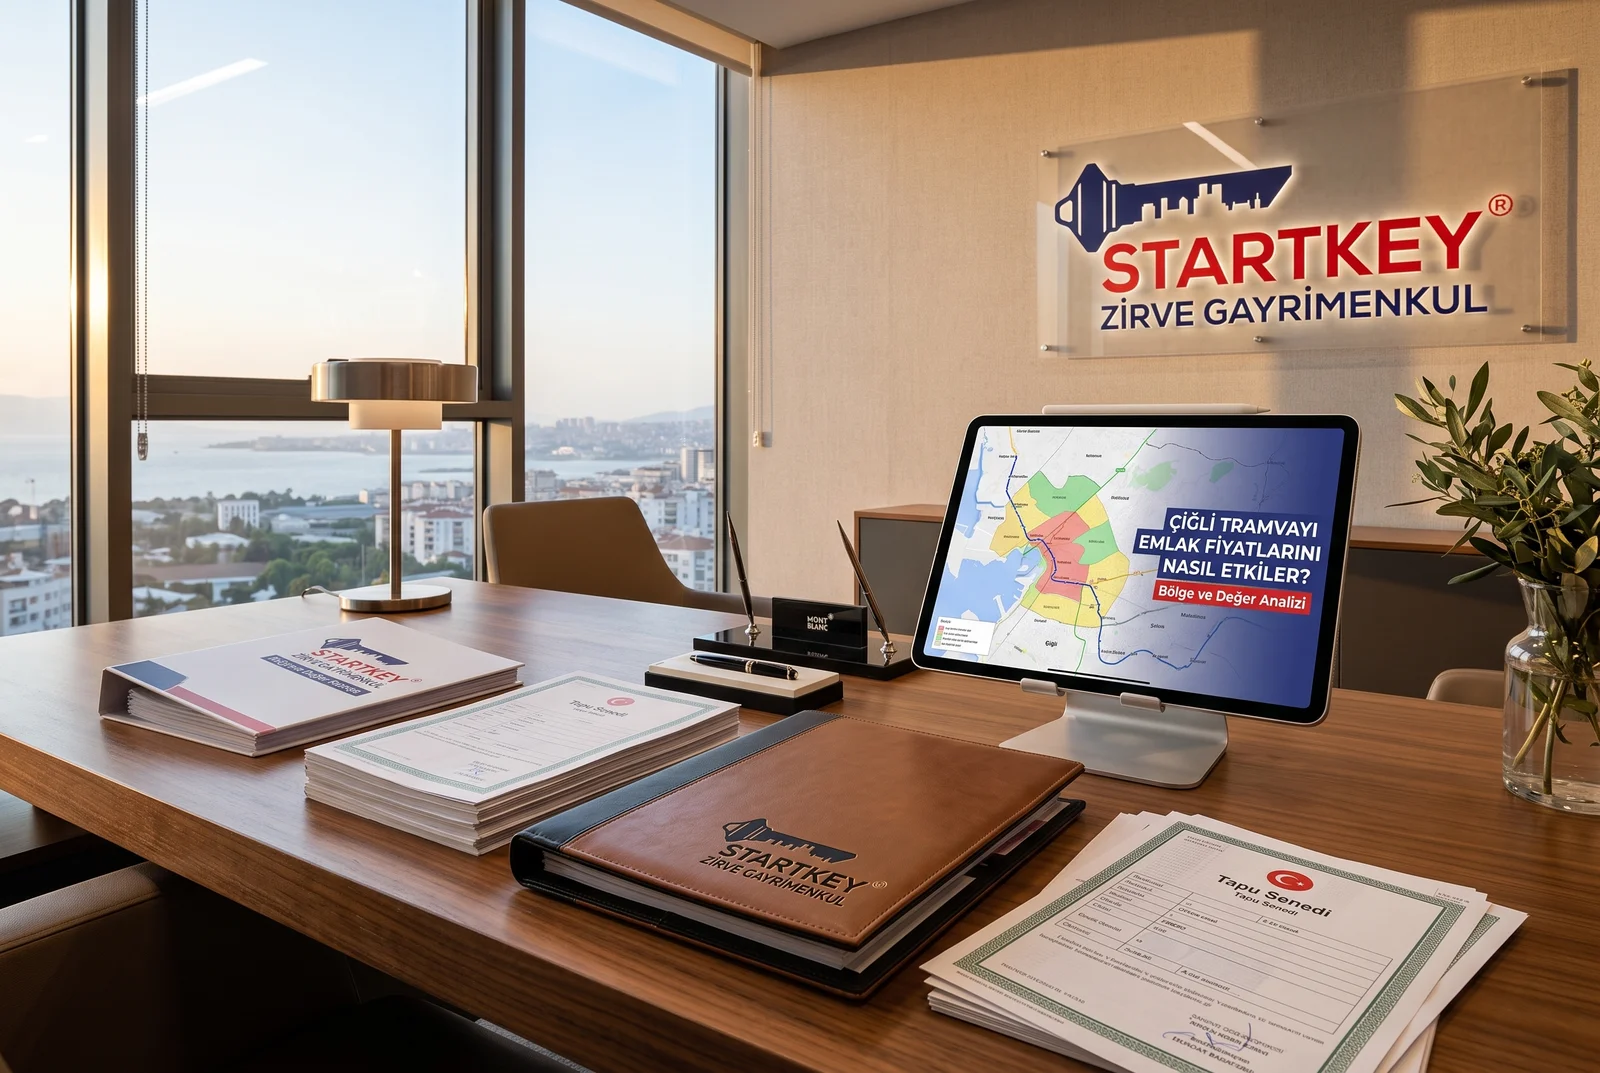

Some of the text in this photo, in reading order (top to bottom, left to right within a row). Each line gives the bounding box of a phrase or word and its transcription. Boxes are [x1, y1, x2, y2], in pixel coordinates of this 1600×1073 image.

[1102, 211, 1483, 293] STARTKEY
[1100, 284, 1488, 330] ZİRVE GAYRİMENKUL
[1169, 511, 1318, 538] ÇİĞLİ TRAMVAYI
[1138, 534, 1322, 562] EMLAK FİYATLARINI
[1162, 558, 1311, 585] NASIL ETKİLER?
[1158, 585, 1307, 610] Bölge ve Değer Analizi
[807, 615, 828, 625] MONT
[807, 622, 829, 631] BLANC
[311, 649, 409, 683] STARTKEY
[700, 855, 846, 908] ZİRVE GAYRİMENKUL
[718, 844, 870, 894] STARTKEY
[1218, 874, 1333, 918] Tapu Senedi
[1235, 892, 1260, 904] Tapu
